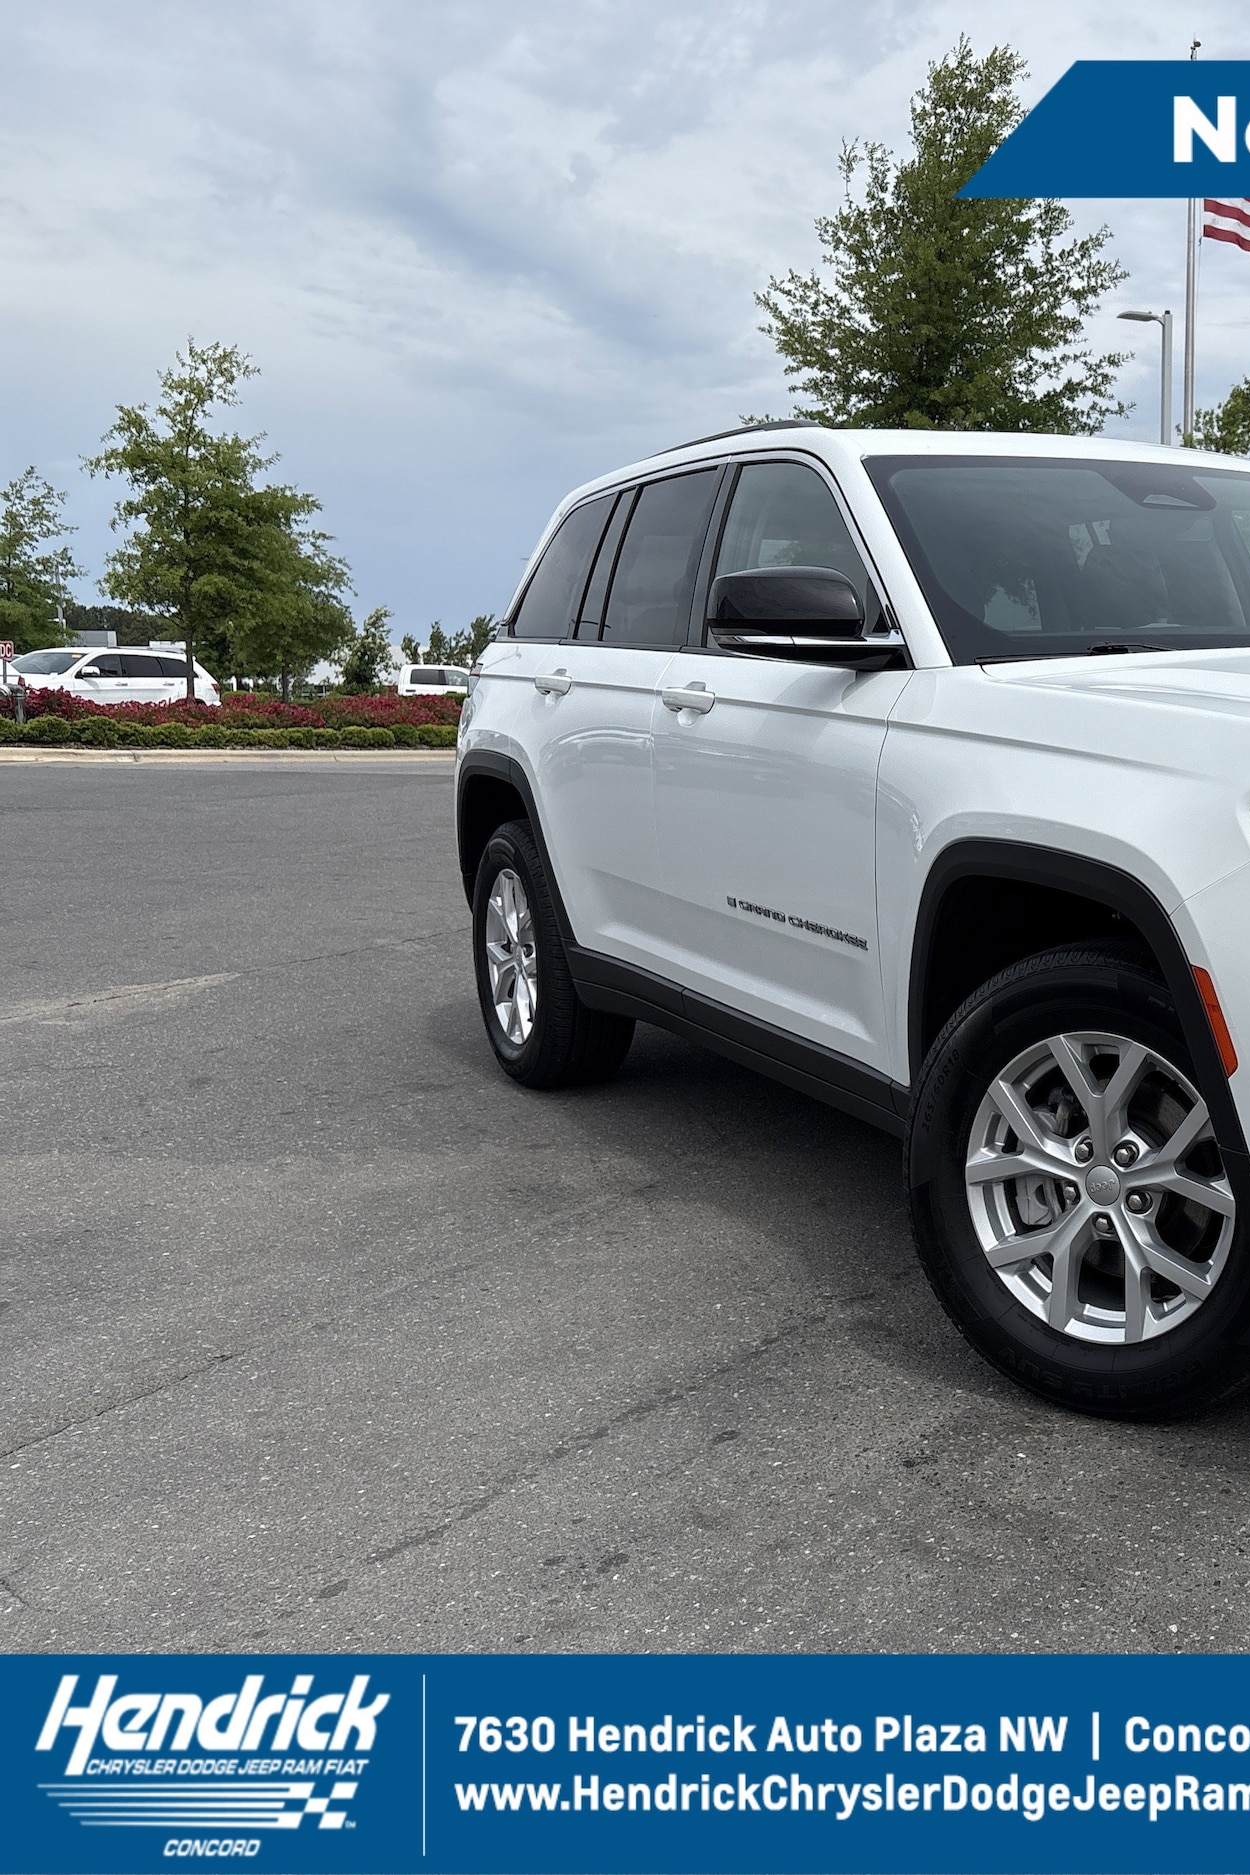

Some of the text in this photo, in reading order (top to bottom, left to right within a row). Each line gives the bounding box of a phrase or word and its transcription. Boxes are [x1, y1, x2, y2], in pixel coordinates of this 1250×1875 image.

[738, 899, 868, 950] GRAND CHEROKEE
[1090, 1178, 1116, 1193] Jeep
